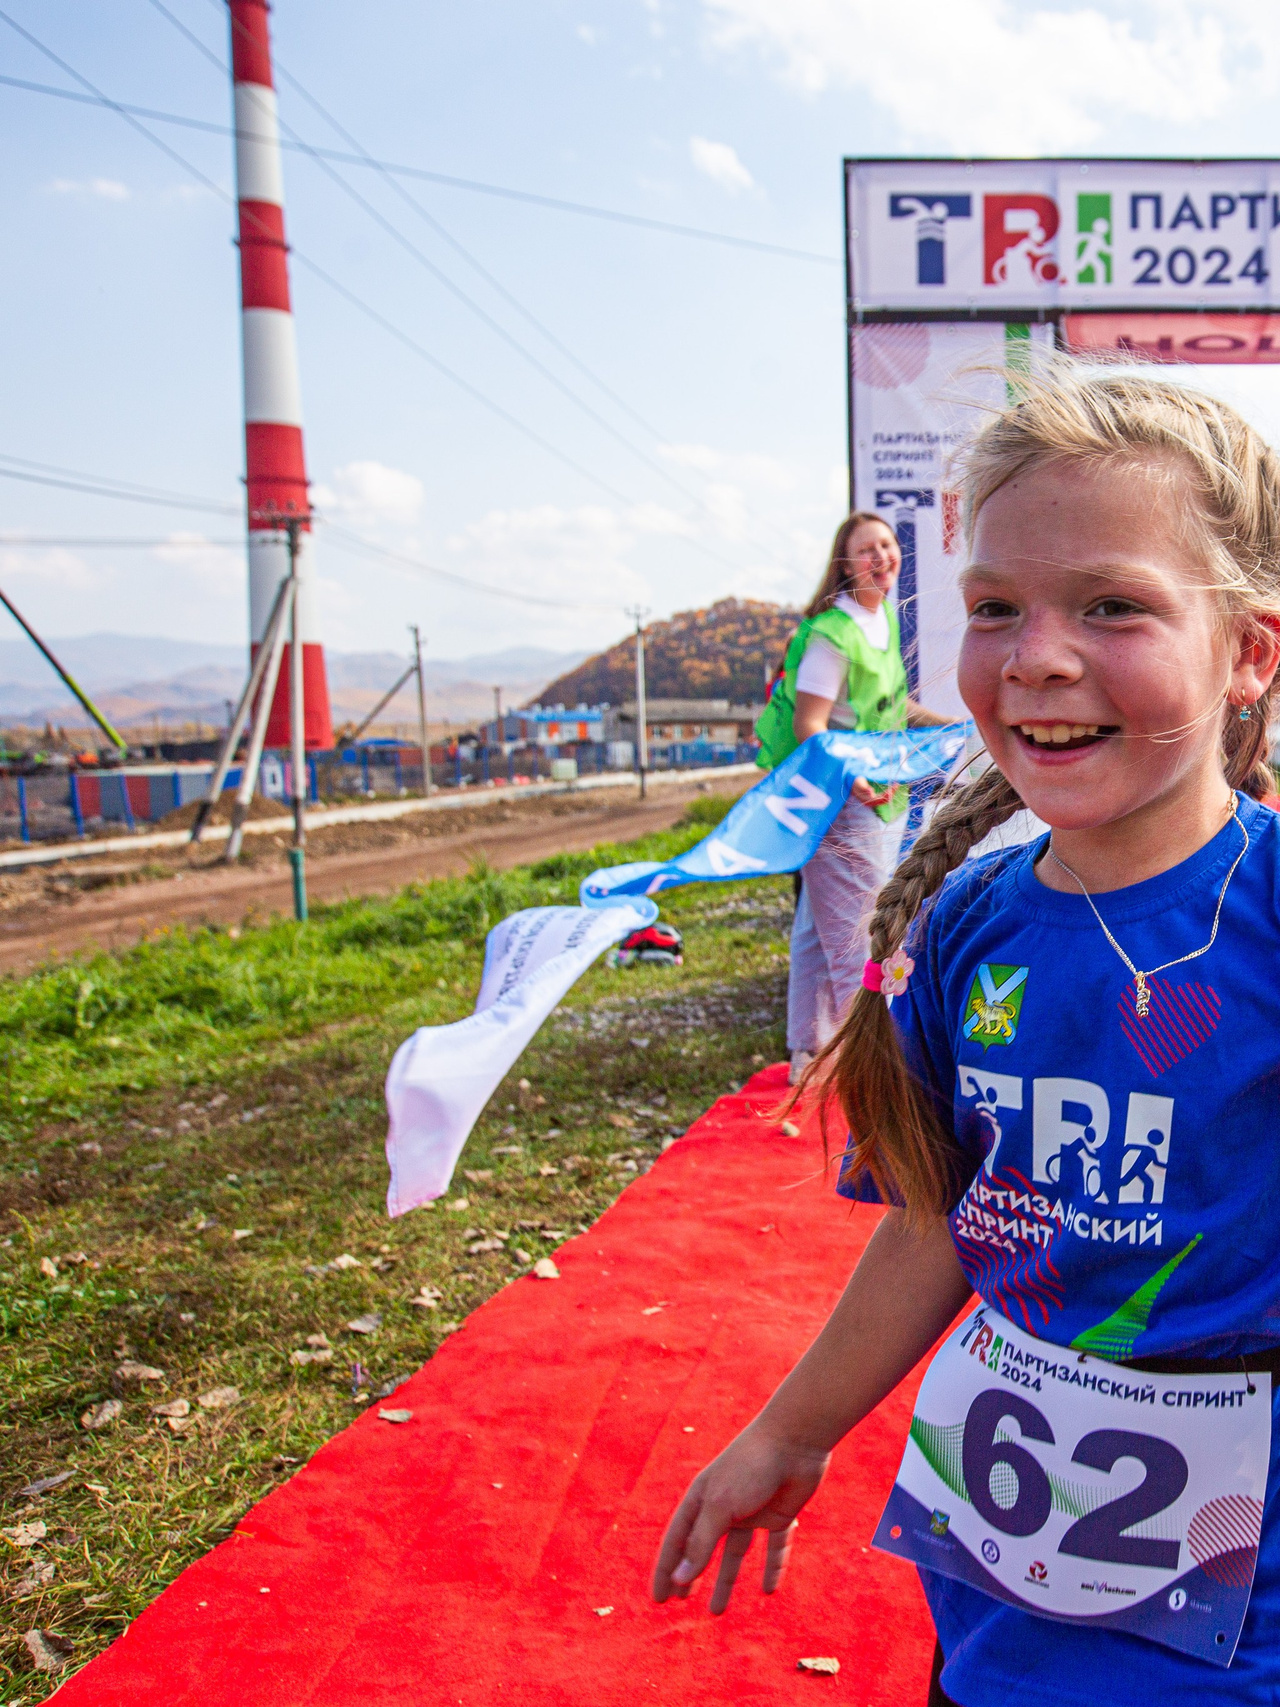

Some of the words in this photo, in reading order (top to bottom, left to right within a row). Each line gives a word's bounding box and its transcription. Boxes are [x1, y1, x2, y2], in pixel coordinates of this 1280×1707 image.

[1131, 248, 1270, 285] 2024
[957, 1064, 1175, 1206] TRI
[966, 1177, 1164, 1247] АРТИЗАНСКИЙ
[1000, 1361, 1043, 1394] 2024
[1003, 1341, 1156, 1405] ПАРТИЗАНСКИЙ
[1161, 1390, 1247, 1409] СПРИНТ
[962, 1387, 1190, 1571] 62
